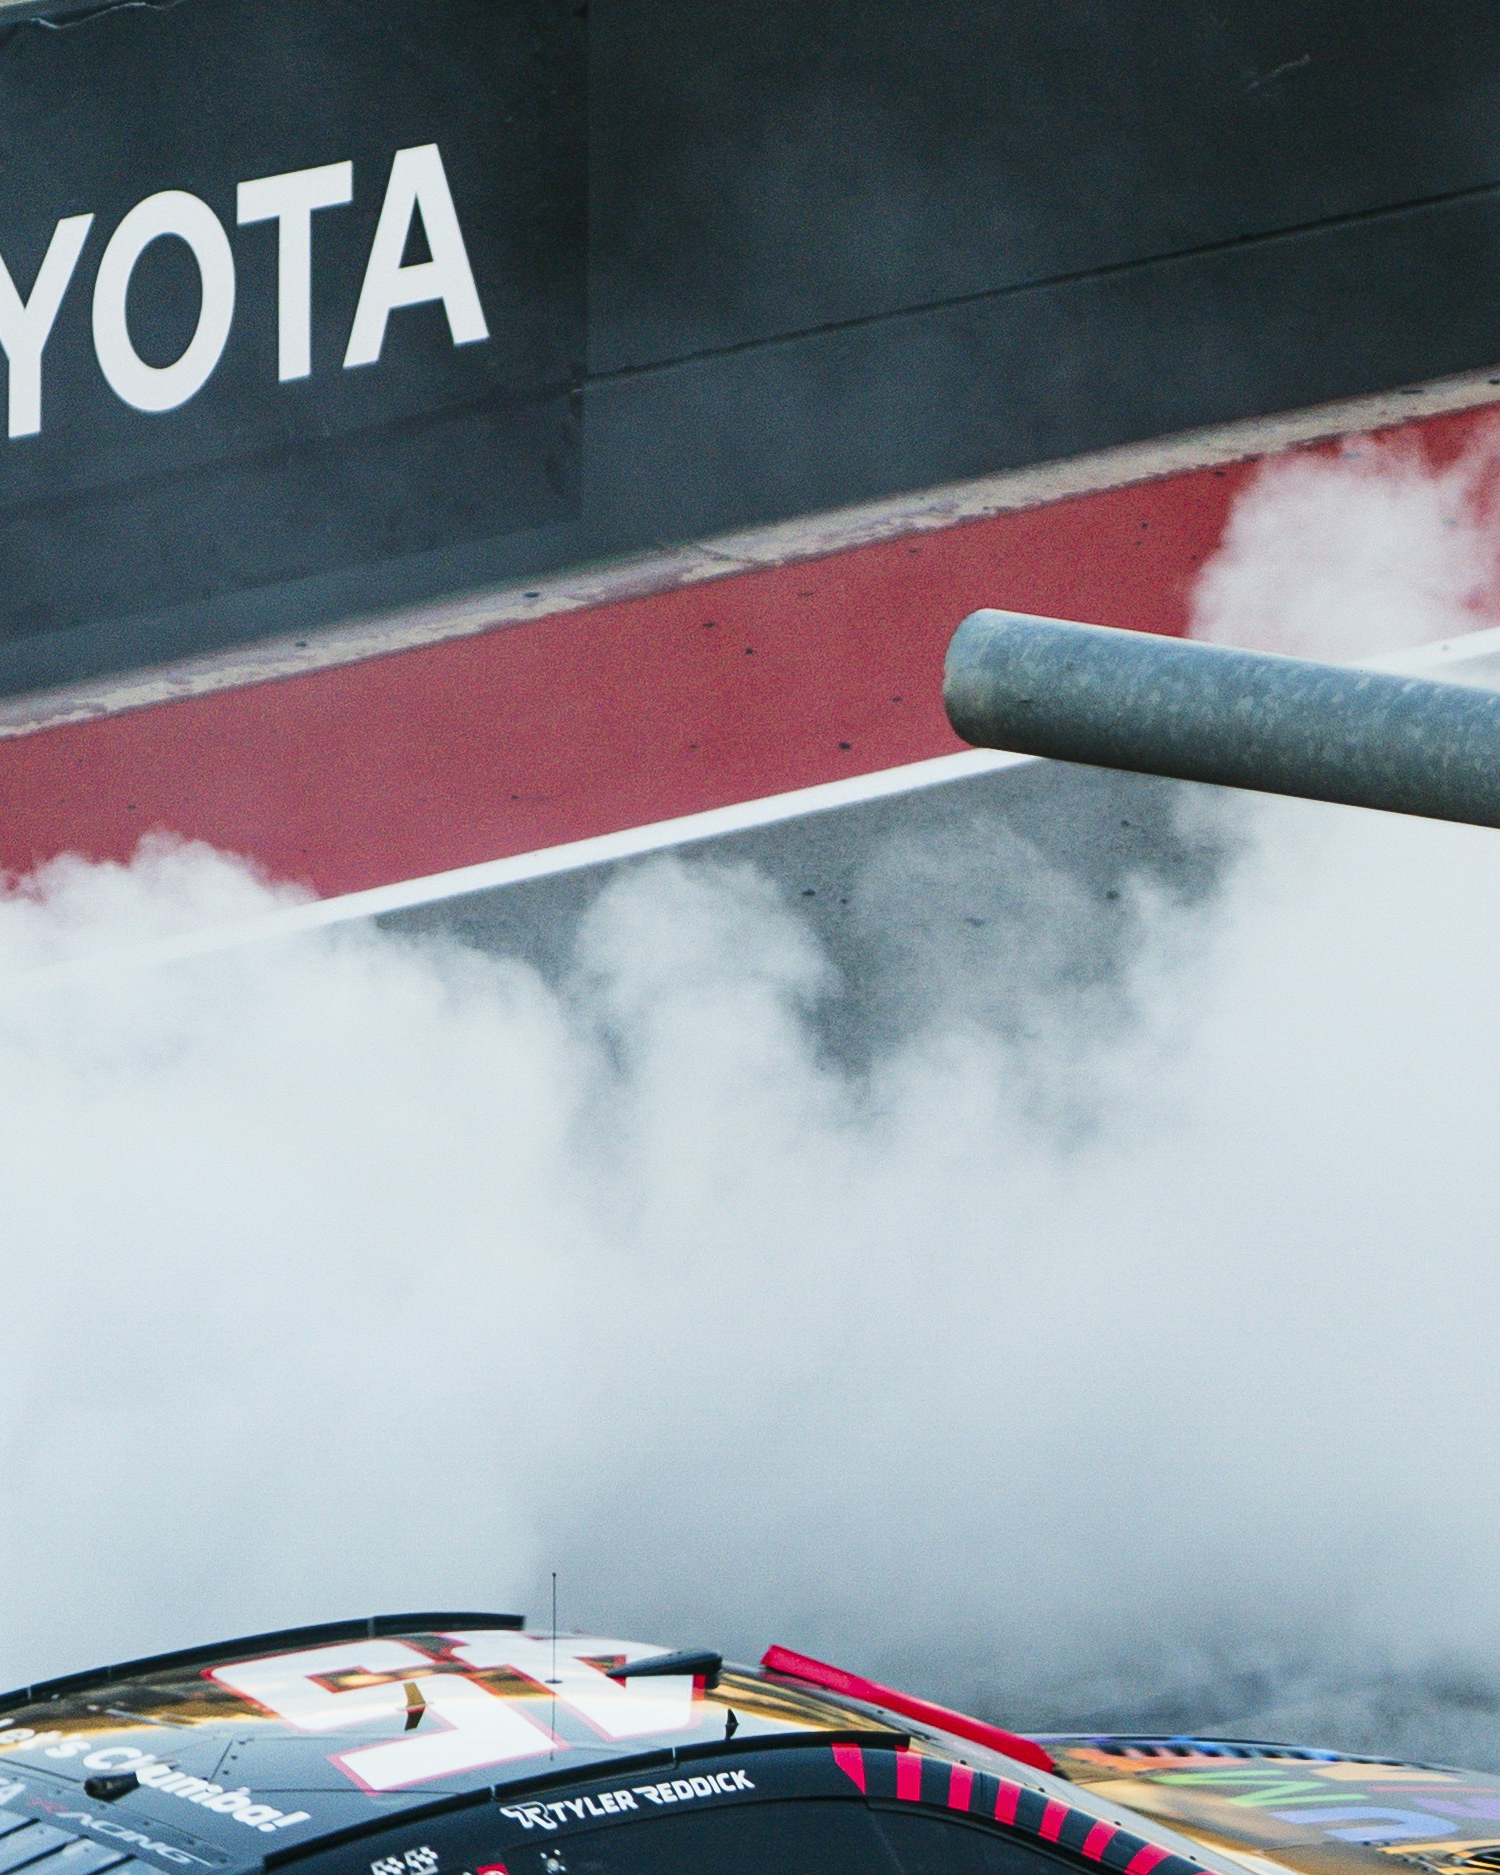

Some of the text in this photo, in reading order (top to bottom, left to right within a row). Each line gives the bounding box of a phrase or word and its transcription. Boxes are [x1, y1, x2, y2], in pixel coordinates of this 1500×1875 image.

[82, 1746, 312, 1834] Chumba!
[549, 1790, 639, 1822] TYLER
[631, 1769, 756, 1804] REDDICK
